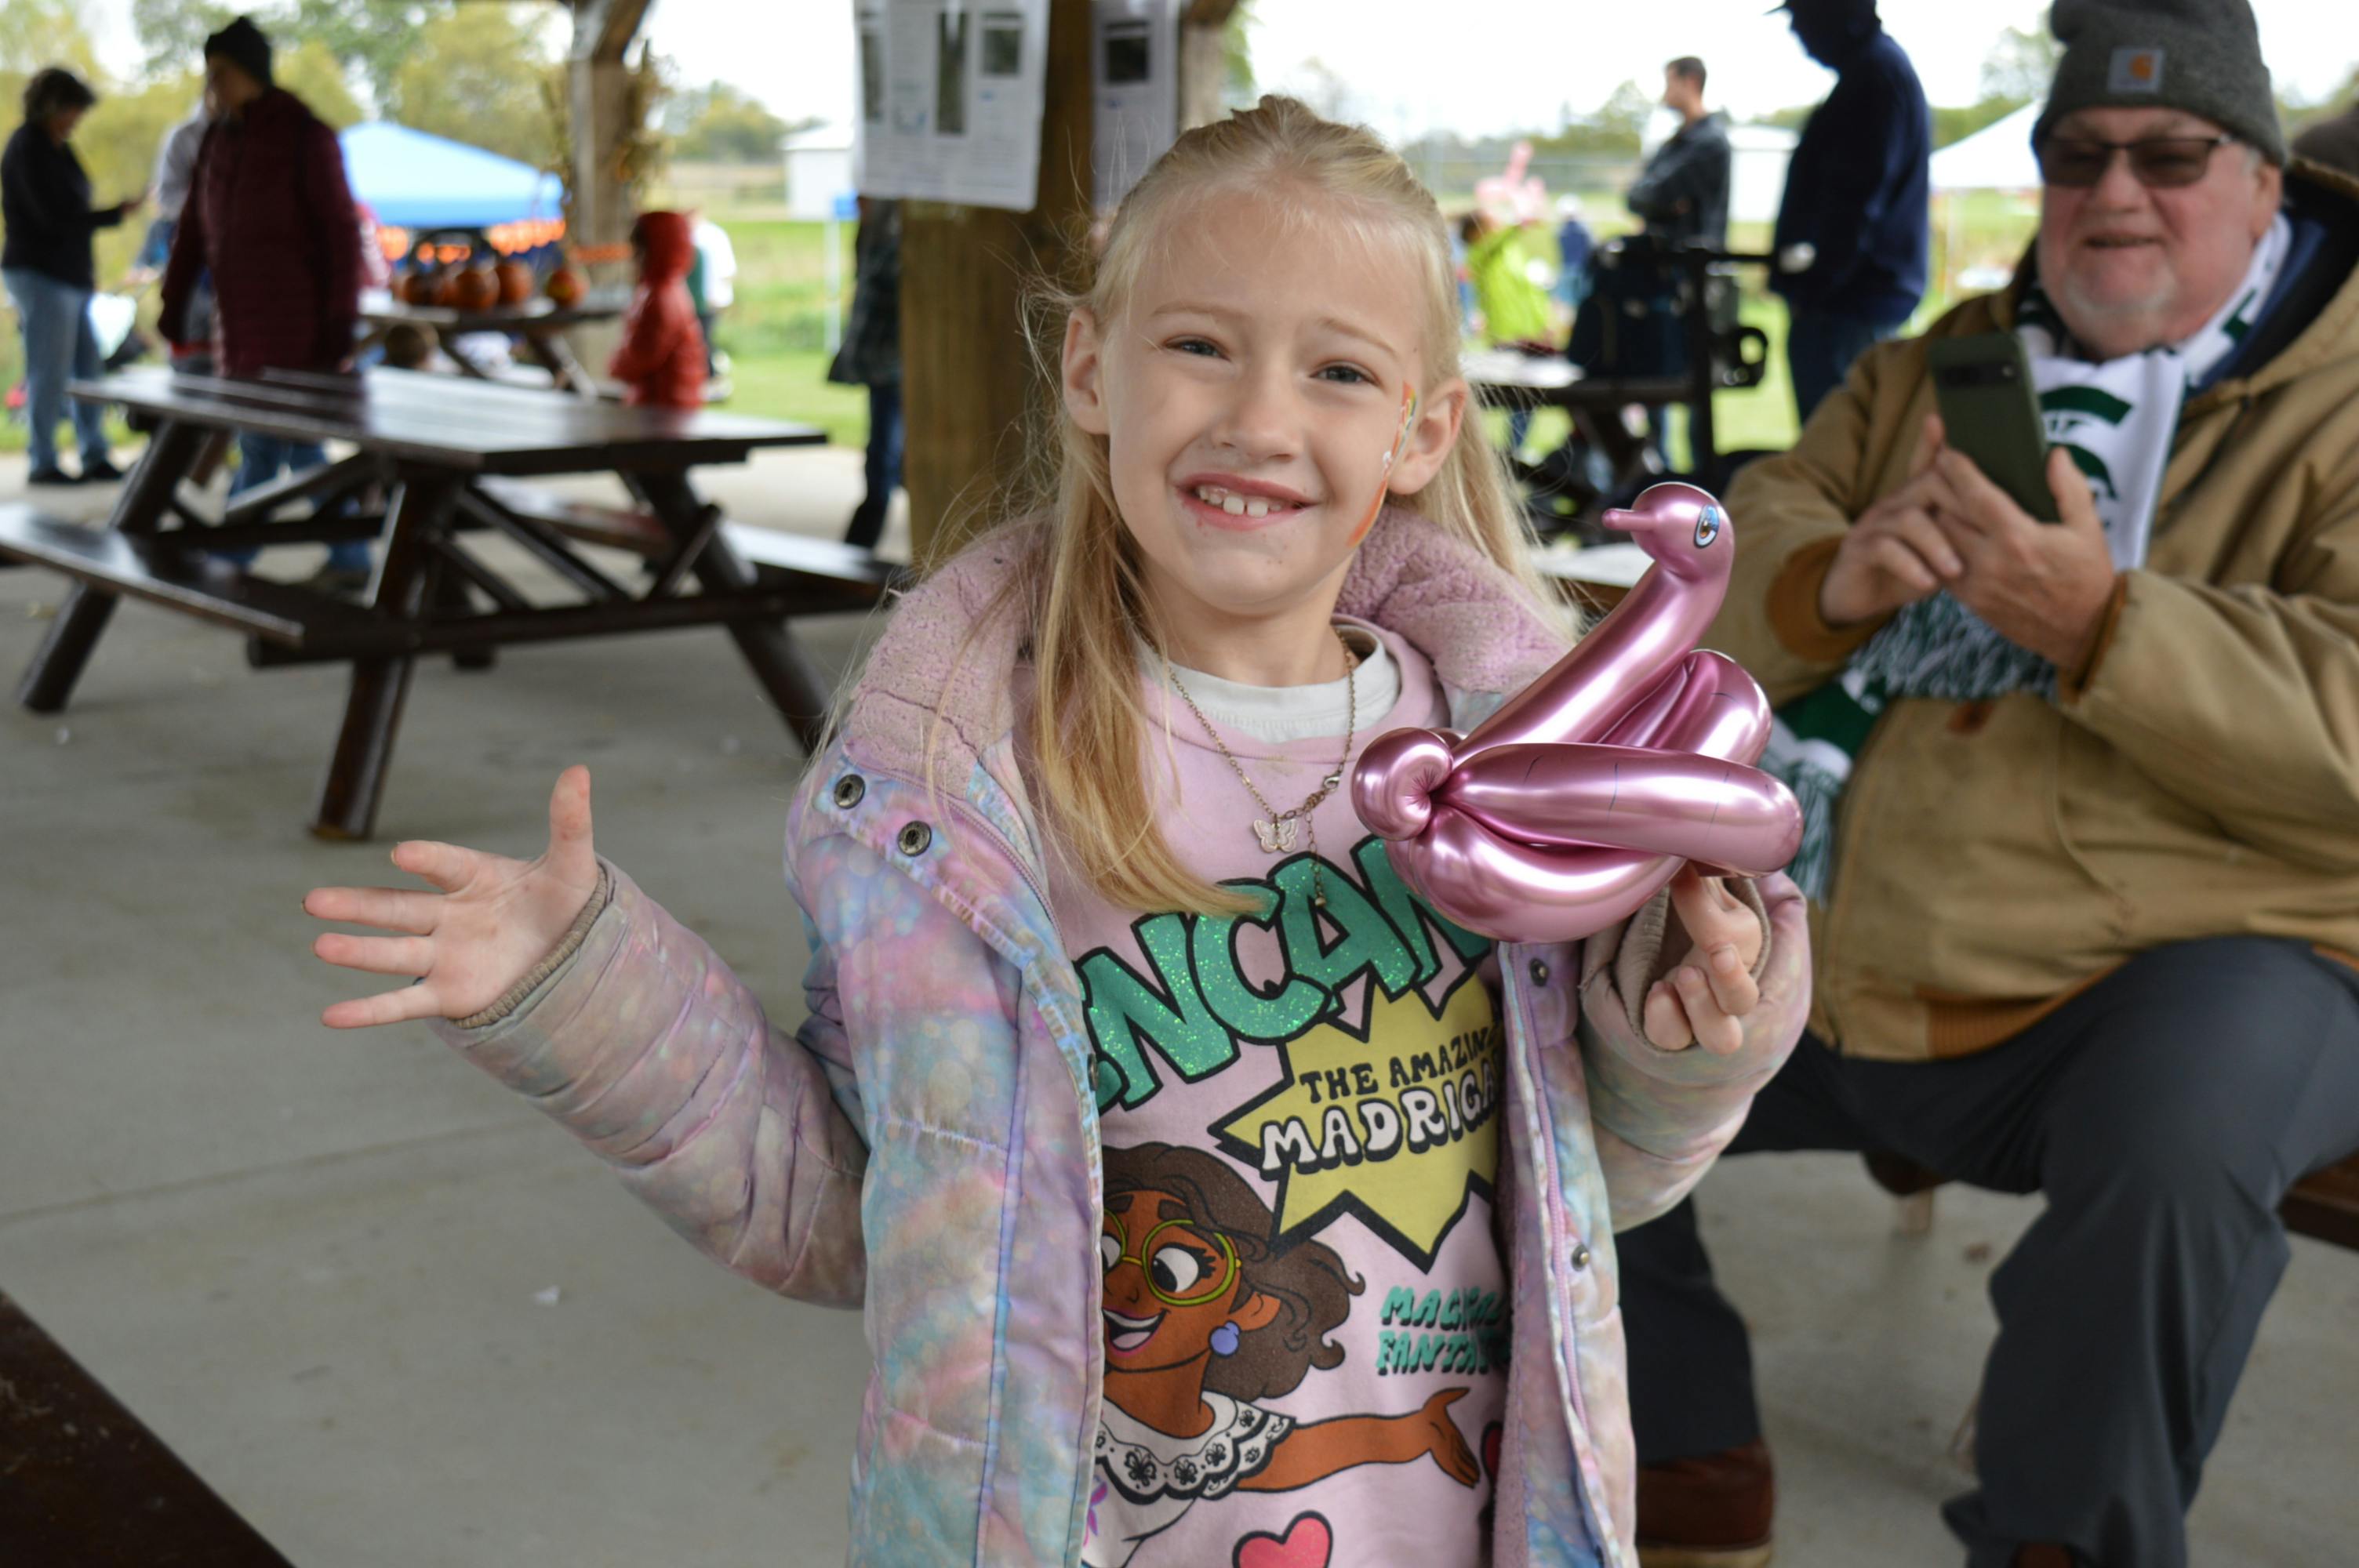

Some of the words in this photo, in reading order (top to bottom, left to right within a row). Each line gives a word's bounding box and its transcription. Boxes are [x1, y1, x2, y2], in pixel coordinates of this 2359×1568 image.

[1071, 833, 1490, 1117] NCAN
[1259, 1052, 1499, 1181] MADRIGA
[1299, 1062, 1379, 1104] THE
